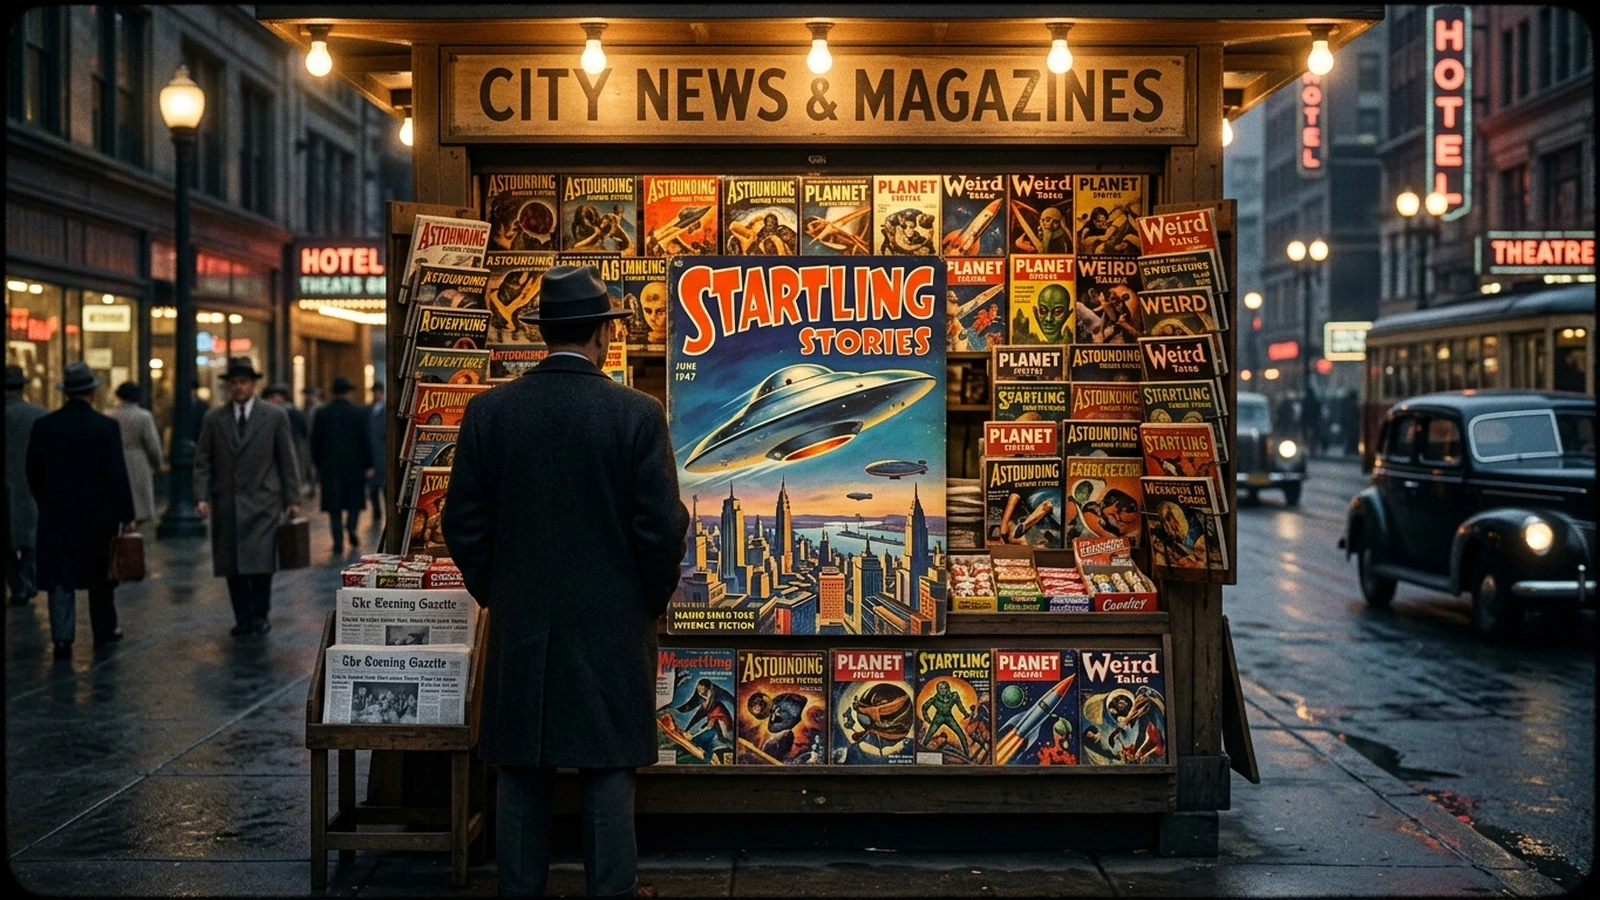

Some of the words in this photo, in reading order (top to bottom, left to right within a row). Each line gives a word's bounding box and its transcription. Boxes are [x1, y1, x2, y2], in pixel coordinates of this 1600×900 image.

[479, 67, 612, 122] CITY
[636, 67, 788, 122] NEWS
[806, 77, 838, 121] &
[855, 67, 1163, 122] MAGAZINES
[1434, 19, 1465, 206] HOTEL
[805, 185, 868, 203] PLANNET
[878, 180, 938, 194] PLANET
[942, 175, 1004, 198] Weird
[1011, 175, 1073, 198] Weird
[1080, 177, 1138, 192] PLANET
[1140, 211, 1209, 246] Weird
[301, 247, 385, 275] HOTEL
[1491, 240, 1596, 265] THEATRE
[946, 259, 1003, 276] PLANET
[1016, 259, 1073, 274] PLANET
[1078, 259, 1138, 278] WEIRD
[678, 265, 937, 357] STARTLING
[1140, 295, 1207, 315] WEIRD
[800, 327, 932, 356] STORIES
[675, 362, 697, 370] JUNE
[999, 352, 1061, 368] PLANET
[1144, 343, 1207, 370] Weird
[675, 372, 696, 381] 1947
[989, 428, 1053, 444] PLANET
[1144, 435, 1209, 454] STARTLING
[837, 654, 902, 671] PLANET
[919, 652, 990, 675] STARTLING
[999, 655, 1059, 671] PLANET
[1082, 653, 1160, 683] Weird
